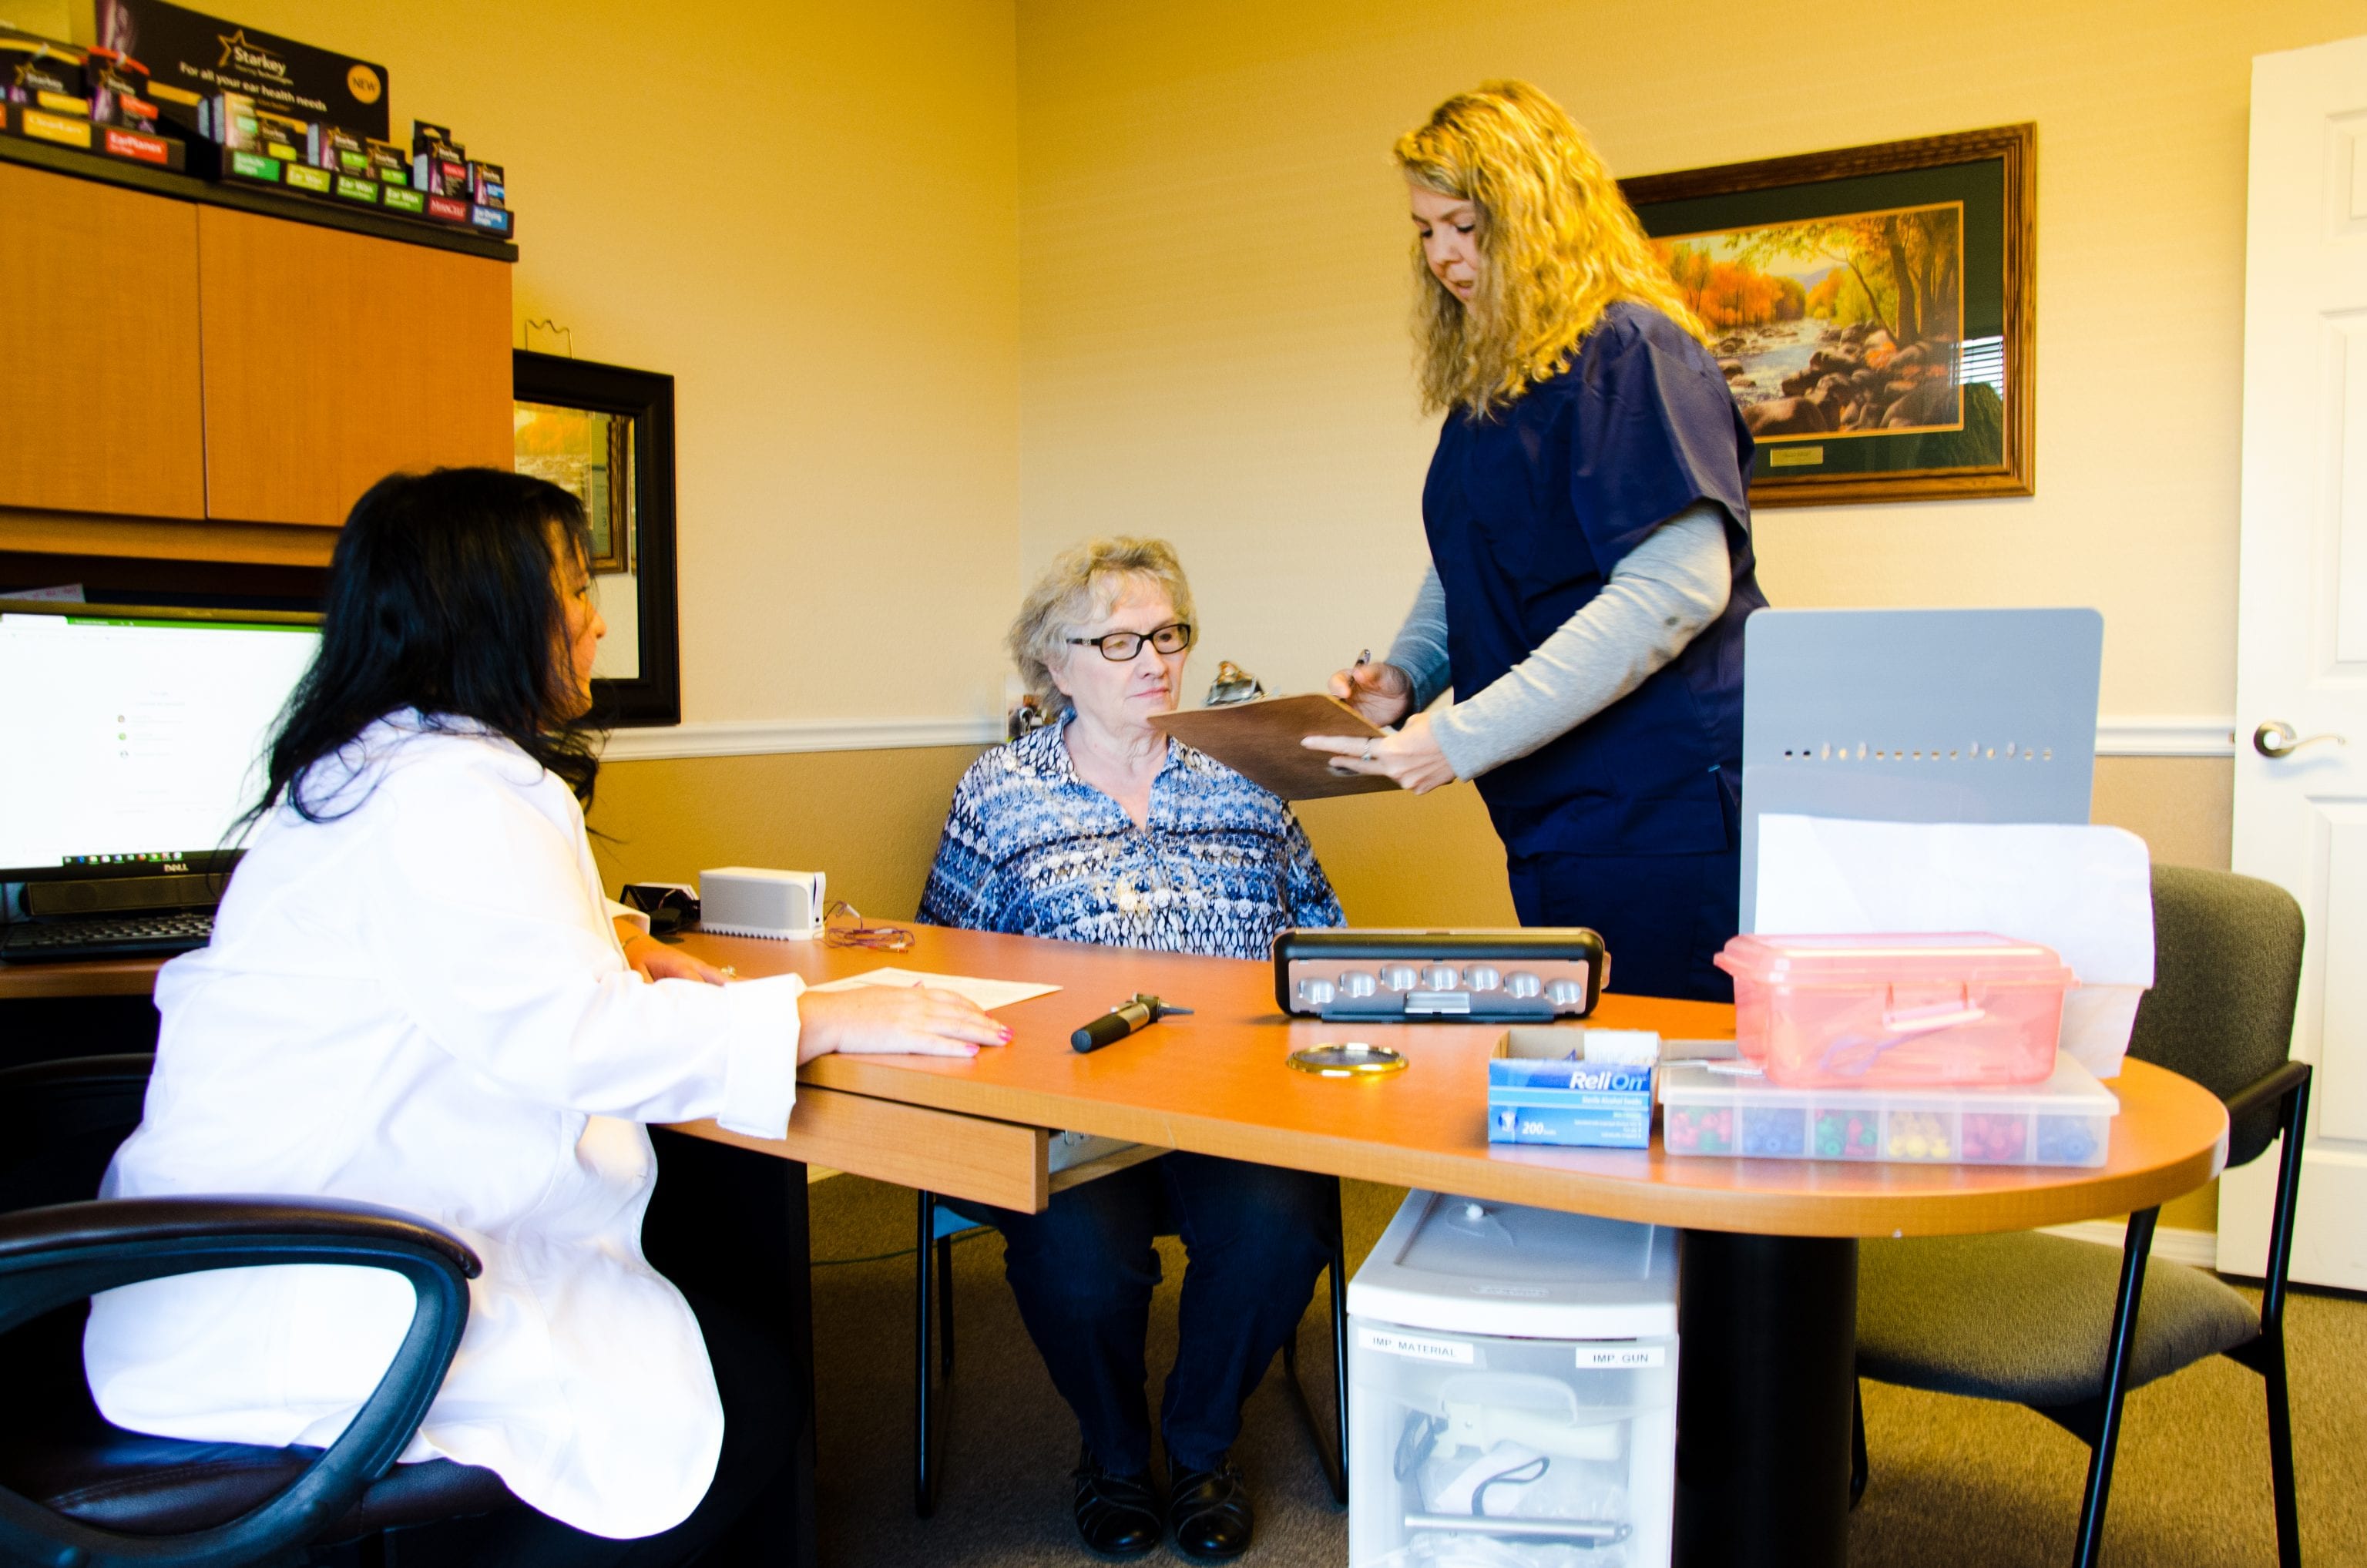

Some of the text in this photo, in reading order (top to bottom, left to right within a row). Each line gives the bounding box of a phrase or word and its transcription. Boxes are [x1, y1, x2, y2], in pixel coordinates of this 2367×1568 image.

[234, 45, 286, 76] Starkey
[179, 60, 199, 78] For
[200, 69, 214, 82] all
[215, 73, 241, 89] your
[243, 81, 260, 93] ear
[260, 84, 295, 103] health
[296, 95, 327, 112] needs
[352, 76, 376, 92] NEW
[164, 862, 189, 872] DELL
[1522, 1121, 1544, 1135] 200
[1398, 1341, 1456, 1358] MATERIAL
[1621, 1353, 1649, 1364] GUN
